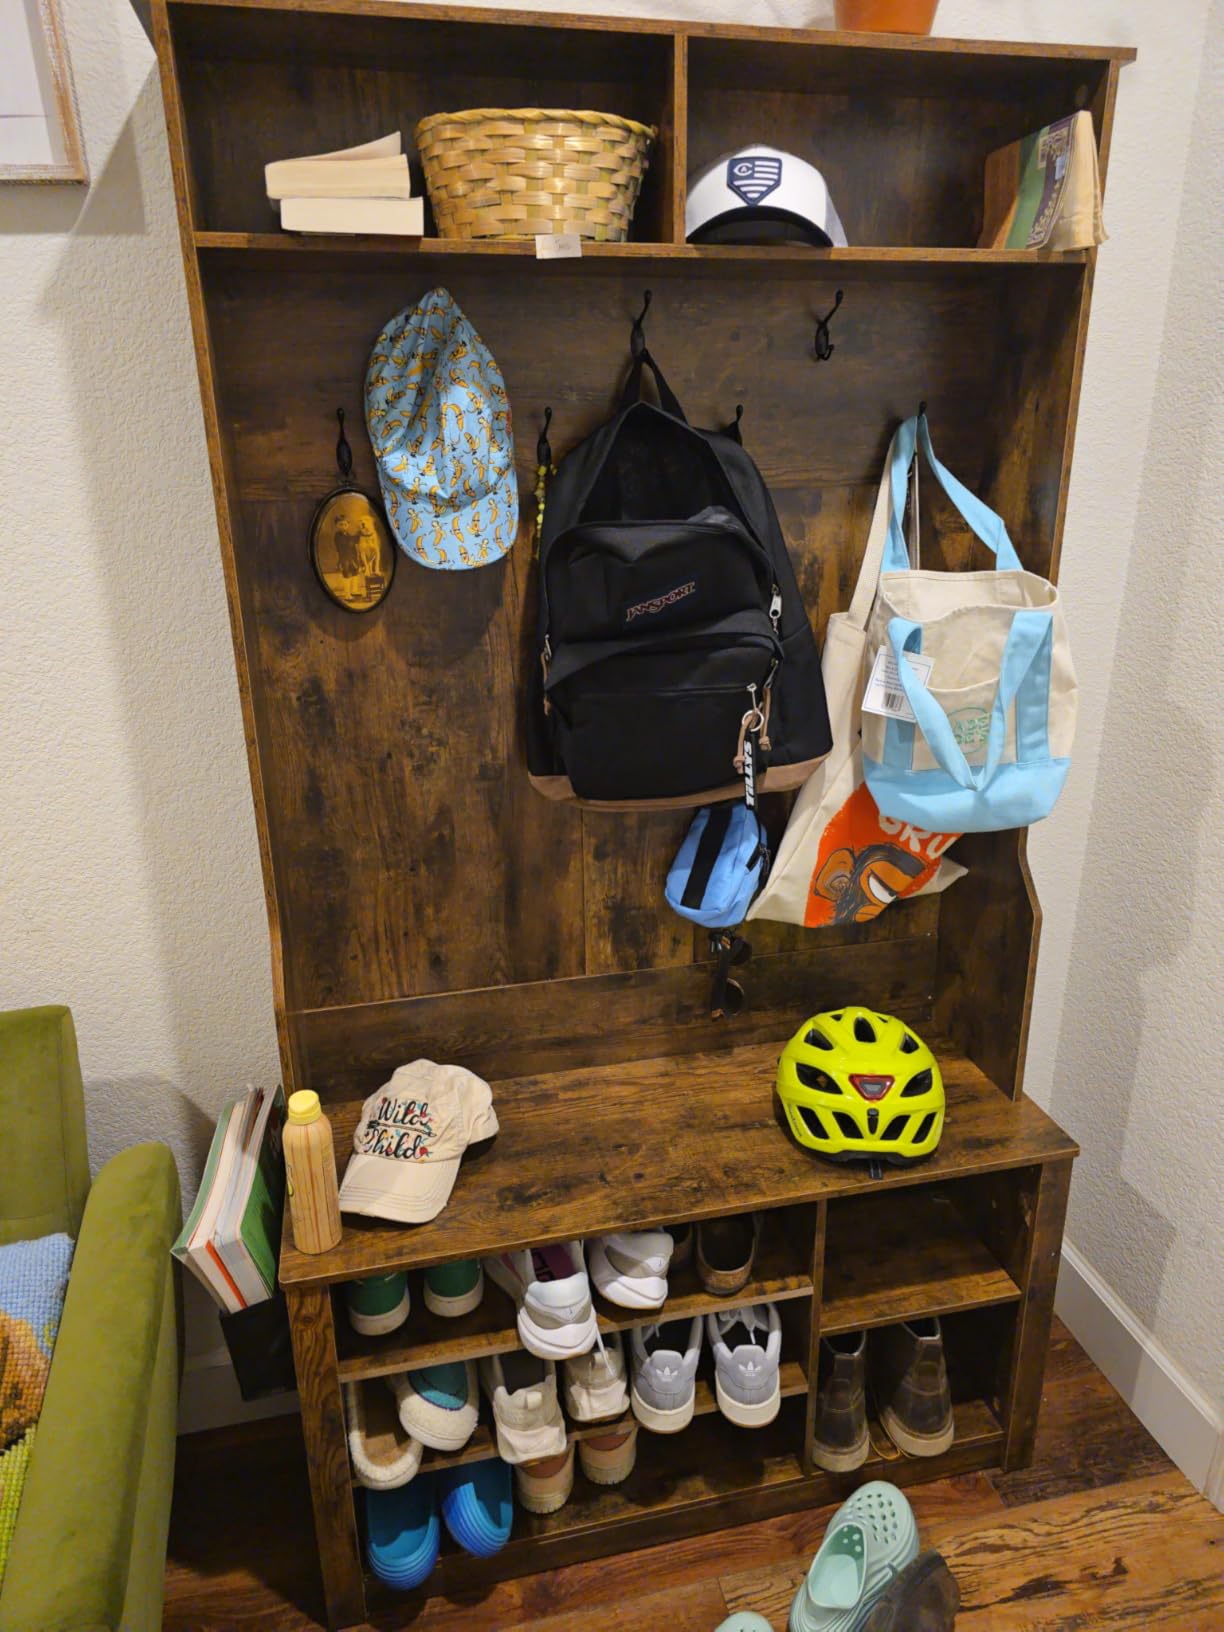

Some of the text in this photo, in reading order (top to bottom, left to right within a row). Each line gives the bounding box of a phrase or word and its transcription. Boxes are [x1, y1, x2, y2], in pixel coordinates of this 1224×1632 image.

[625, 581, 696, 622] JANSPORT
[743, 740, 755, 807] TILLYS
[377, 1097, 430, 1126] Wild
